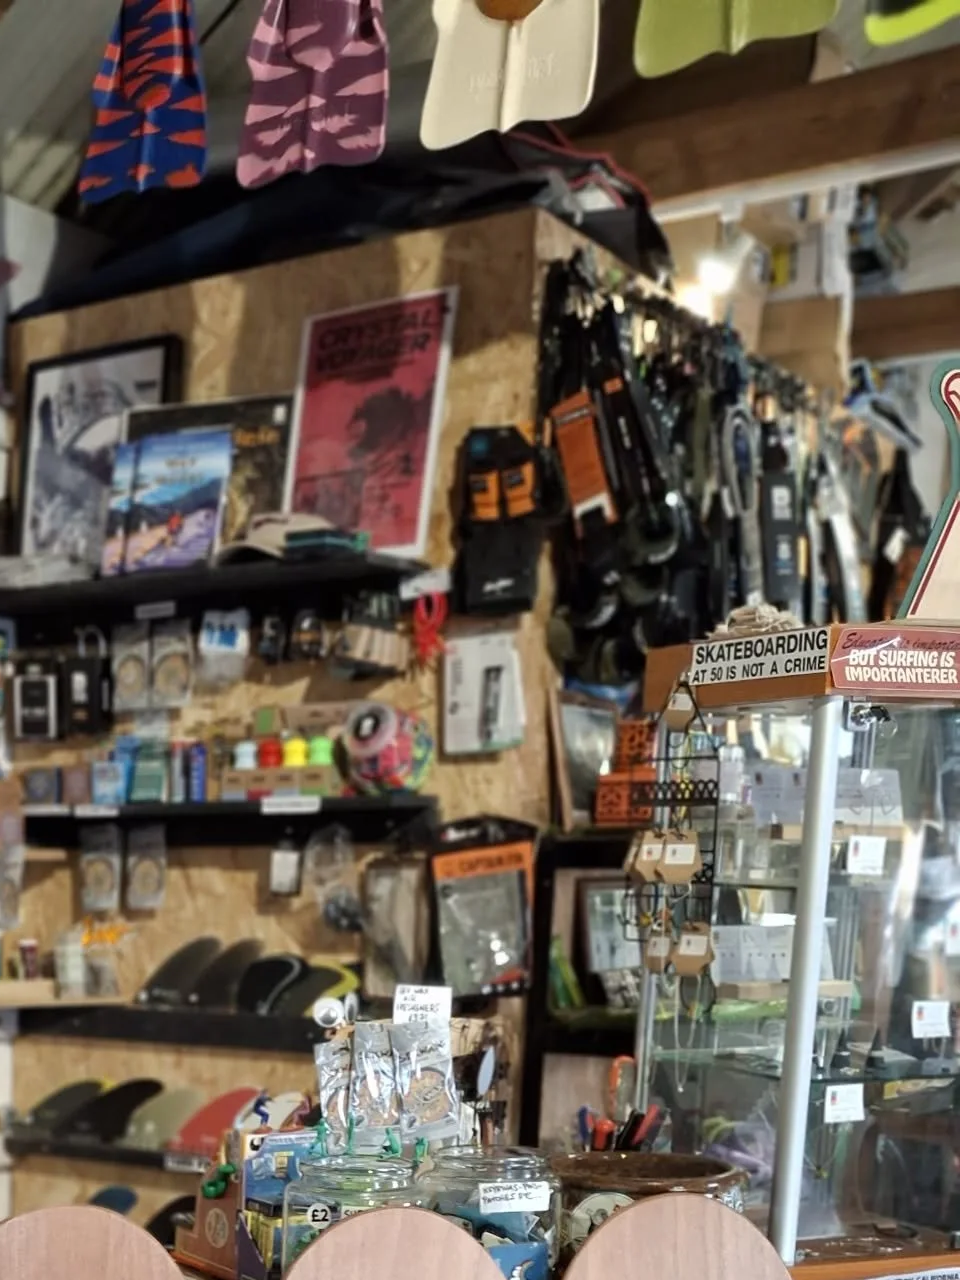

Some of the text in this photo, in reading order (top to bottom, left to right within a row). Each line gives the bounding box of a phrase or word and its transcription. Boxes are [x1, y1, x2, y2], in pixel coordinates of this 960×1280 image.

[696, 630, 827, 665] SKATEBOARDING
[849, 649, 956, 668] BUT SURFING IS
[692, 656, 826, 684] AT 50 IS NOT A CRIME
[844, 666, 958, 684] IMPORTANTERER
[311, 1207, 329, 1222] £2
